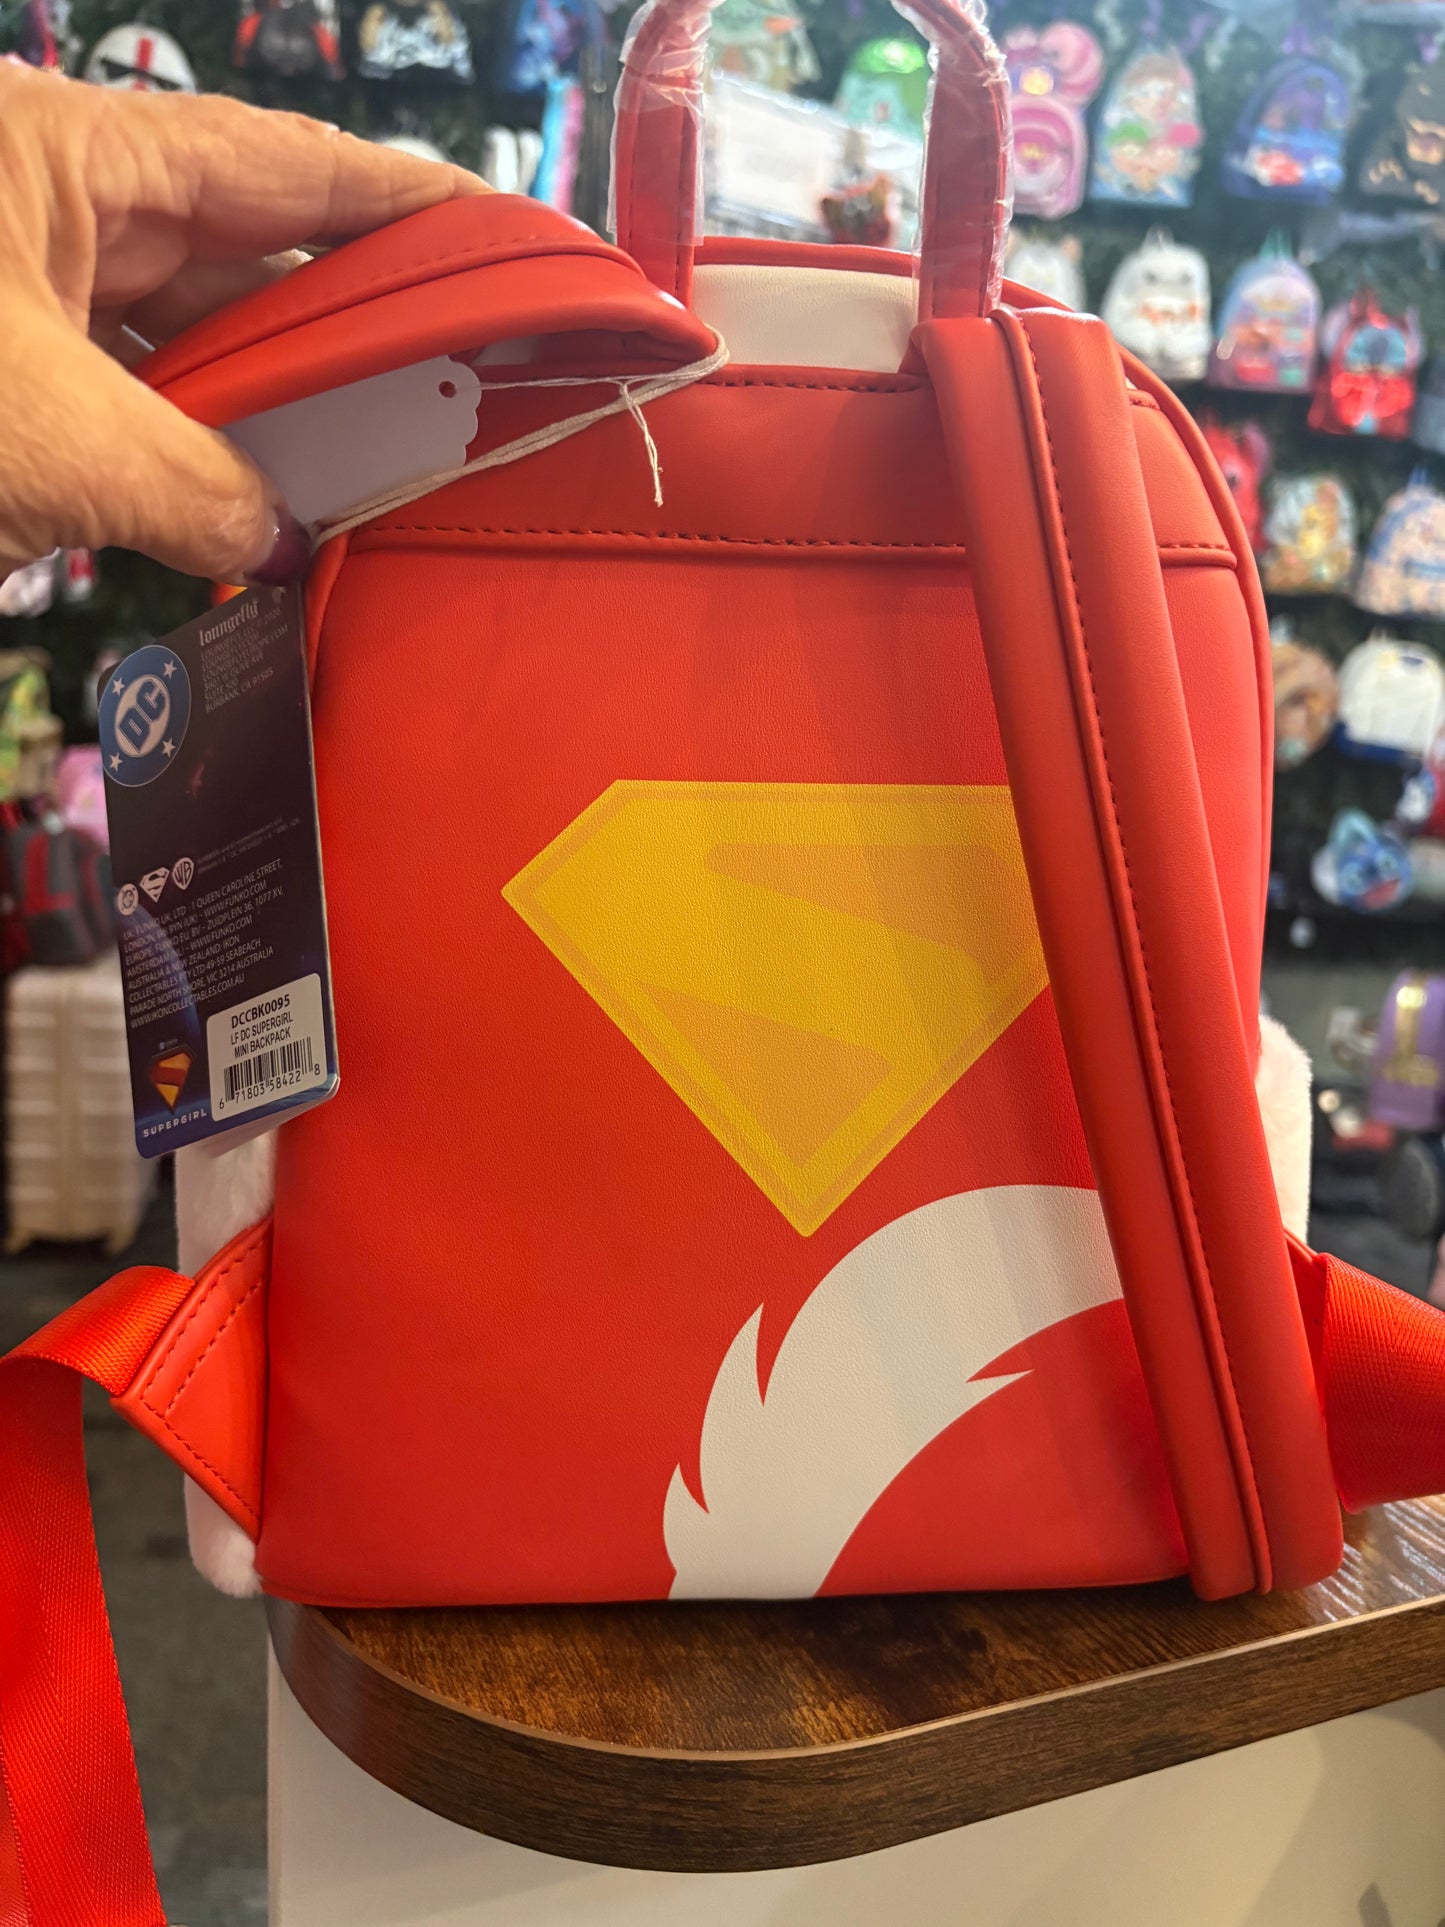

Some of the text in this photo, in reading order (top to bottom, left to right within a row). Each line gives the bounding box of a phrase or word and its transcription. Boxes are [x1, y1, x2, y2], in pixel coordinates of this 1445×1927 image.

[199, 599, 259, 646] loungefly
[119, 678, 166, 753] DC
[196, 888, 220, 907] QUEEN
[221, 871, 254, 895] CAROLINE
[207, 905, 242, 928] ZUIDPLEIN
[254, 891, 270, 906] 1077
[128, 967, 165, 991] AUSTRALIA
[222, 934, 240, 949] IKON
[128, 974, 178, 1004] COLLECTABLES
[192, 962, 205, 976] LTD
[206, 954, 224, 970] 49-59
[225, 938, 261, 961] SEABEACH
[130, 997, 156, 1017] PARADE
[156, 986, 181, 1005] NORTH
[206, 970, 217, 983] VIC
[218, 962, 235, 977] 3214
[236, 946, 273, 970] AUSTRALIA
[231, 994, 290, 1028] DCCBK0095
[231, 1011, 293, 1045] LF DC SUPERGIRL
[234, 1026, 291, 1058] MINI BACKPACK
[219, 1063, 320, 1109] 6 71803 58422 8
[143, 1108, 207, 1137] SUPERGIRL
